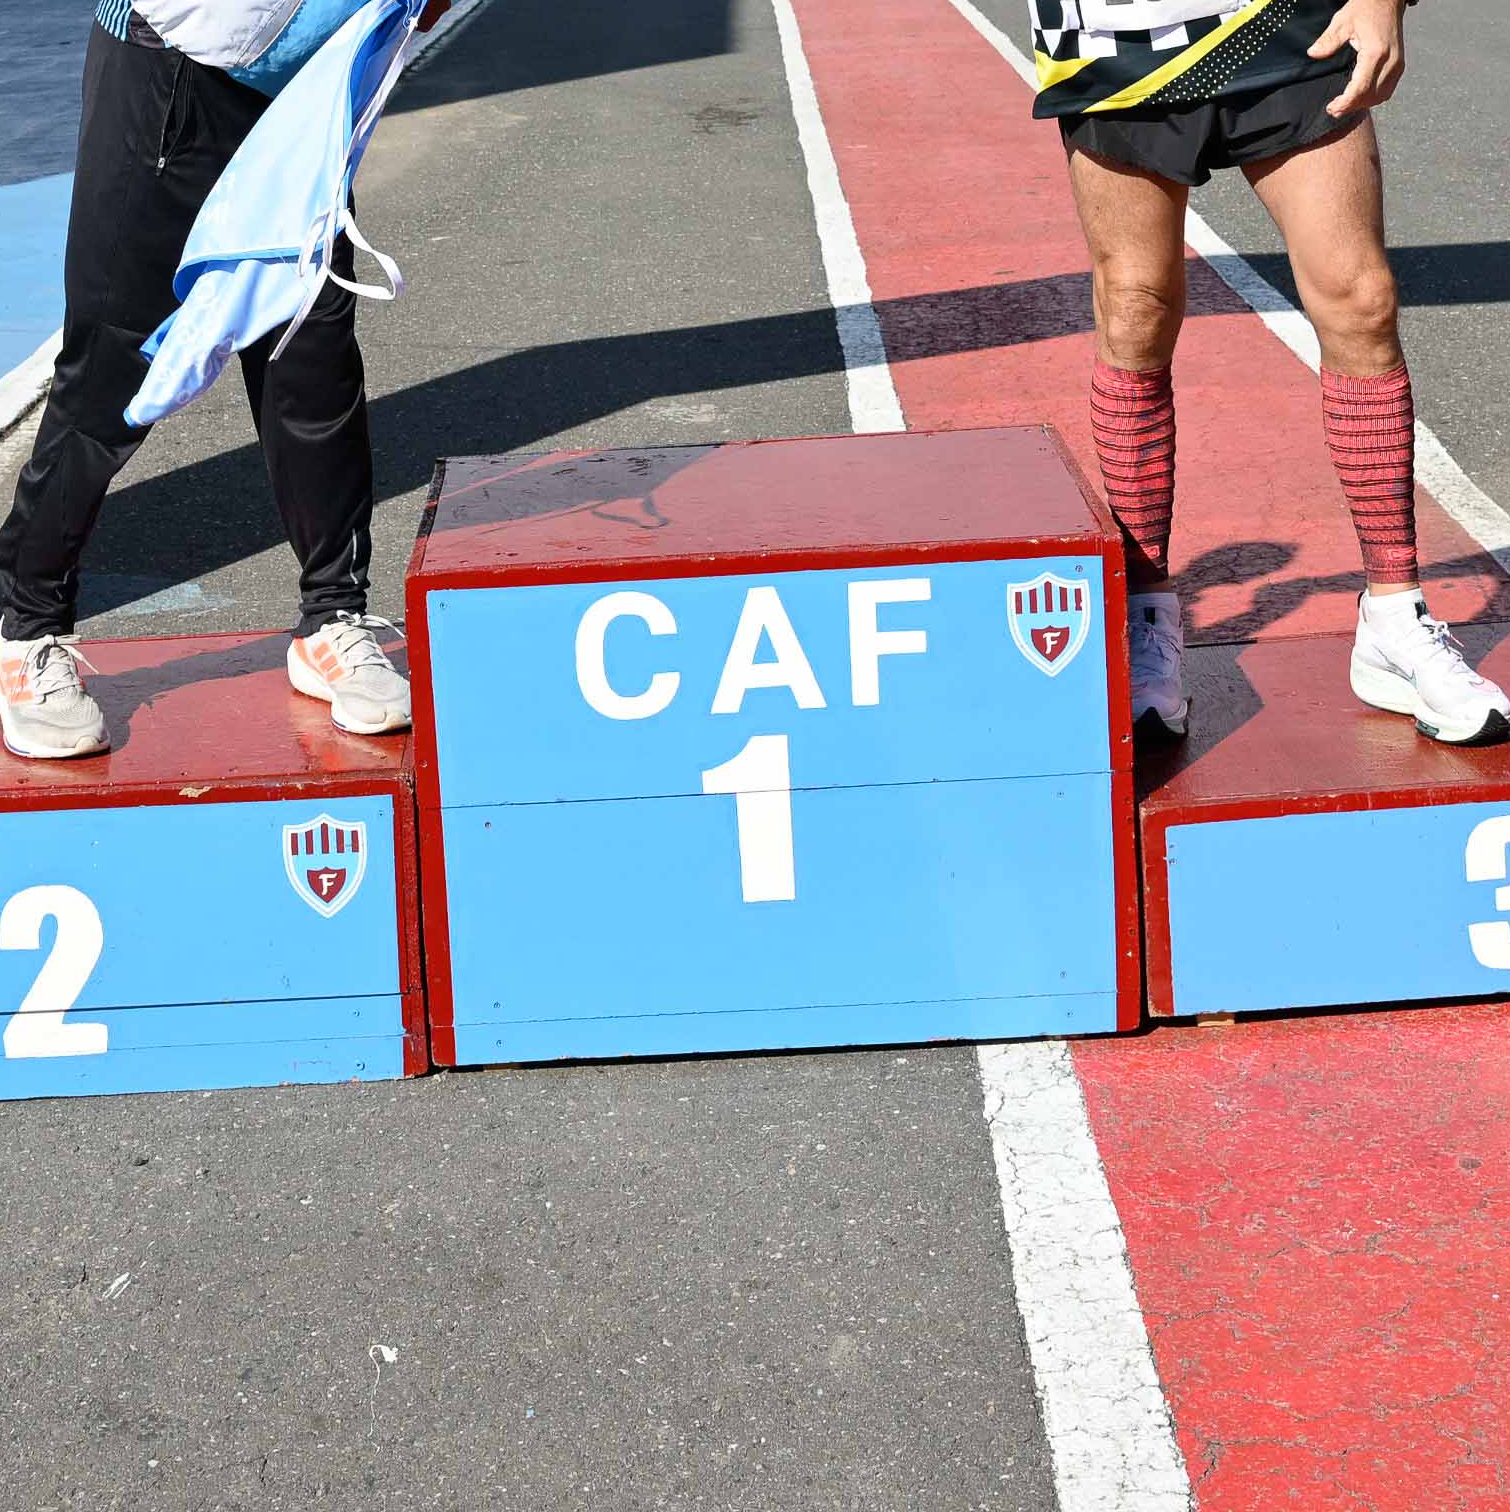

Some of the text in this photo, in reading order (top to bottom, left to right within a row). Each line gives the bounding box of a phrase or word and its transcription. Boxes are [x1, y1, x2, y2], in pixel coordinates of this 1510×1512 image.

[574, 577, 931, 721] CAF
[1042, 631, 1062, 655] F
[701, 733, 796, 904] 1
[318, 872, 338, 896] F
